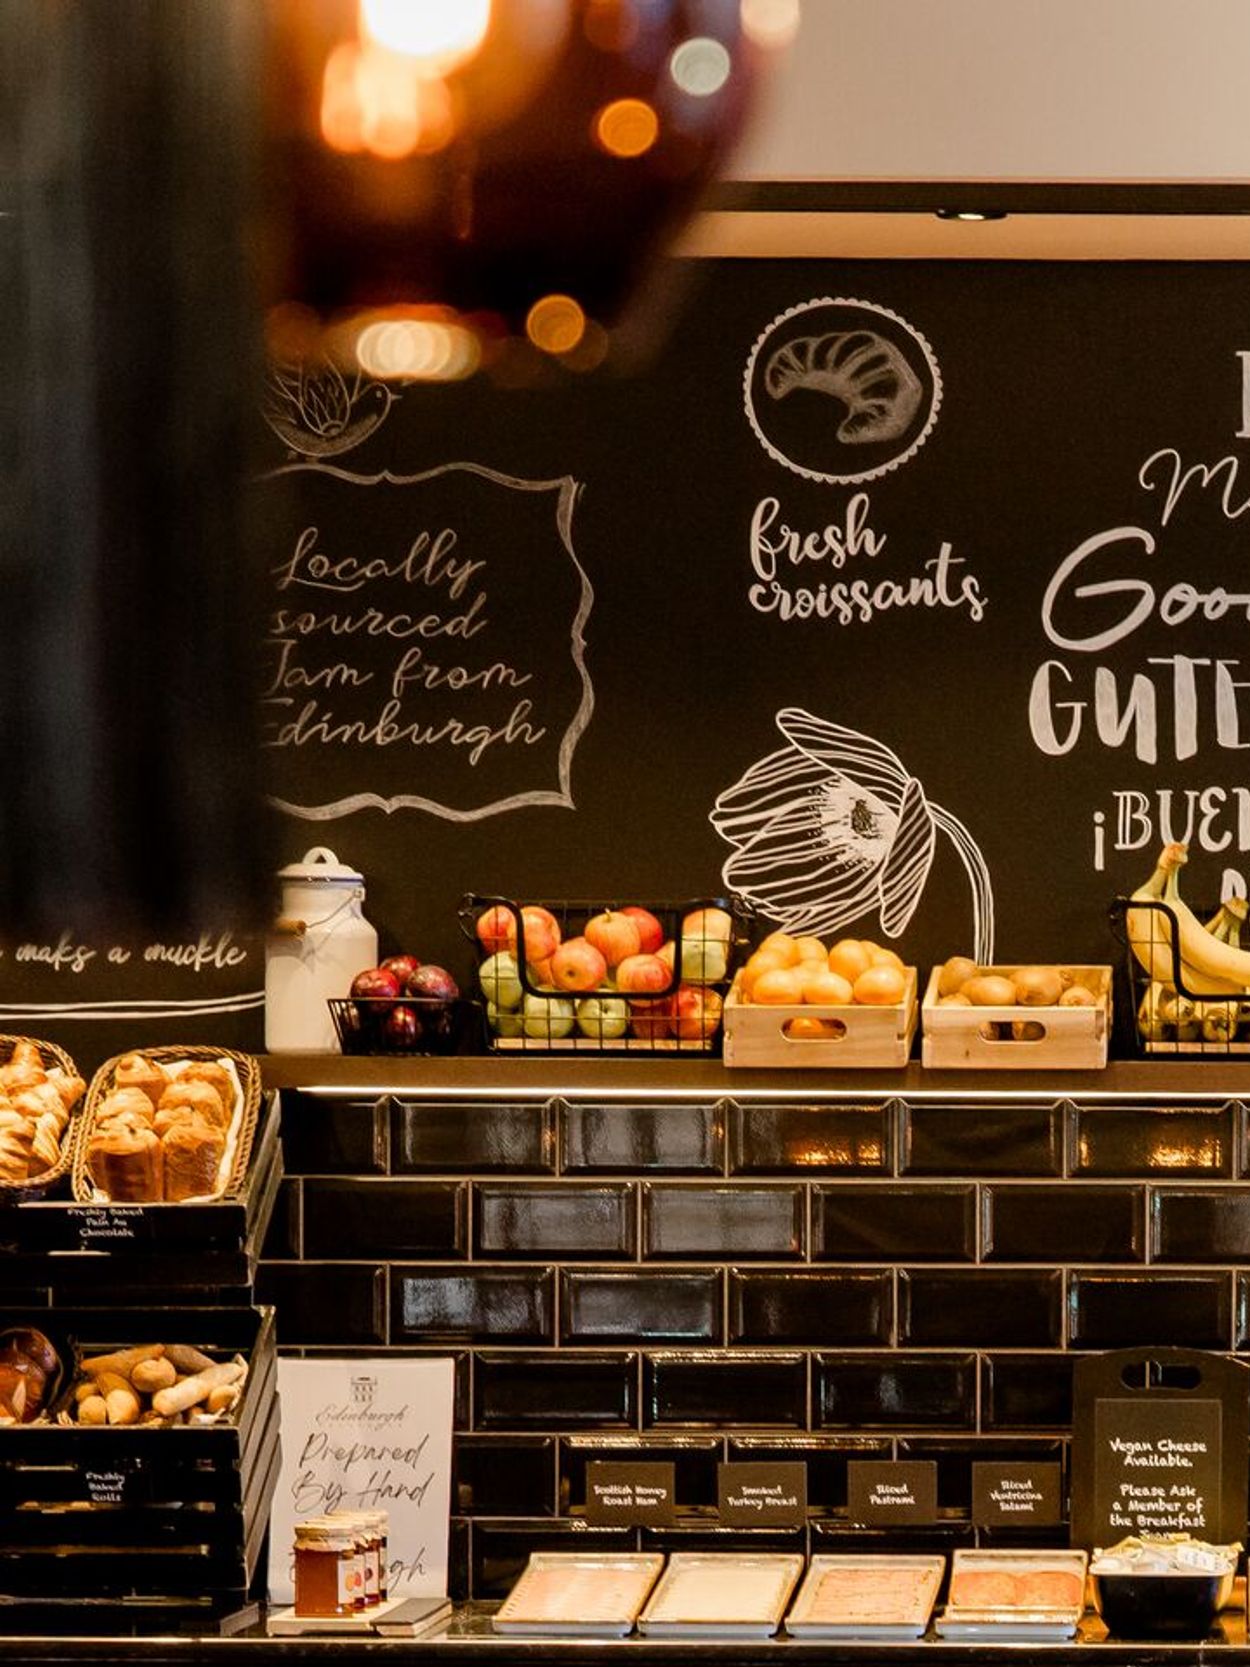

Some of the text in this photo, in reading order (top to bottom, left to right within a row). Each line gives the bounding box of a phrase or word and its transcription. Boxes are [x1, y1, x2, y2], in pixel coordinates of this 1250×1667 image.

[751, 493, 887, 581] fresh
[271, 527, 486, 599] Locally
[748, 542, 989, 626] croissants
[271, 593, 487, 639] sourced
[393, 648, 532, 698] from
[107, 945, 131, 965] a
[144, 930, 247, 973] muckle
[299, 1432, 429, 1472] Prepared
[1109, 1438, 1208, 1454] Vegan Cheese
[1124, 1454, 1193, 1468] Available.
[291, 1469, 435, 1514] By Hand
[869, 1495, 916, 1506] Pastrami
[876, 1484, 908, 1495] Sliced
[1112, 1497, 1205, 1514] a Member of
[1120, 1484, 1197, 1497] Please Ask
[1110, 1512, 1206, 1529] the Breakfast
